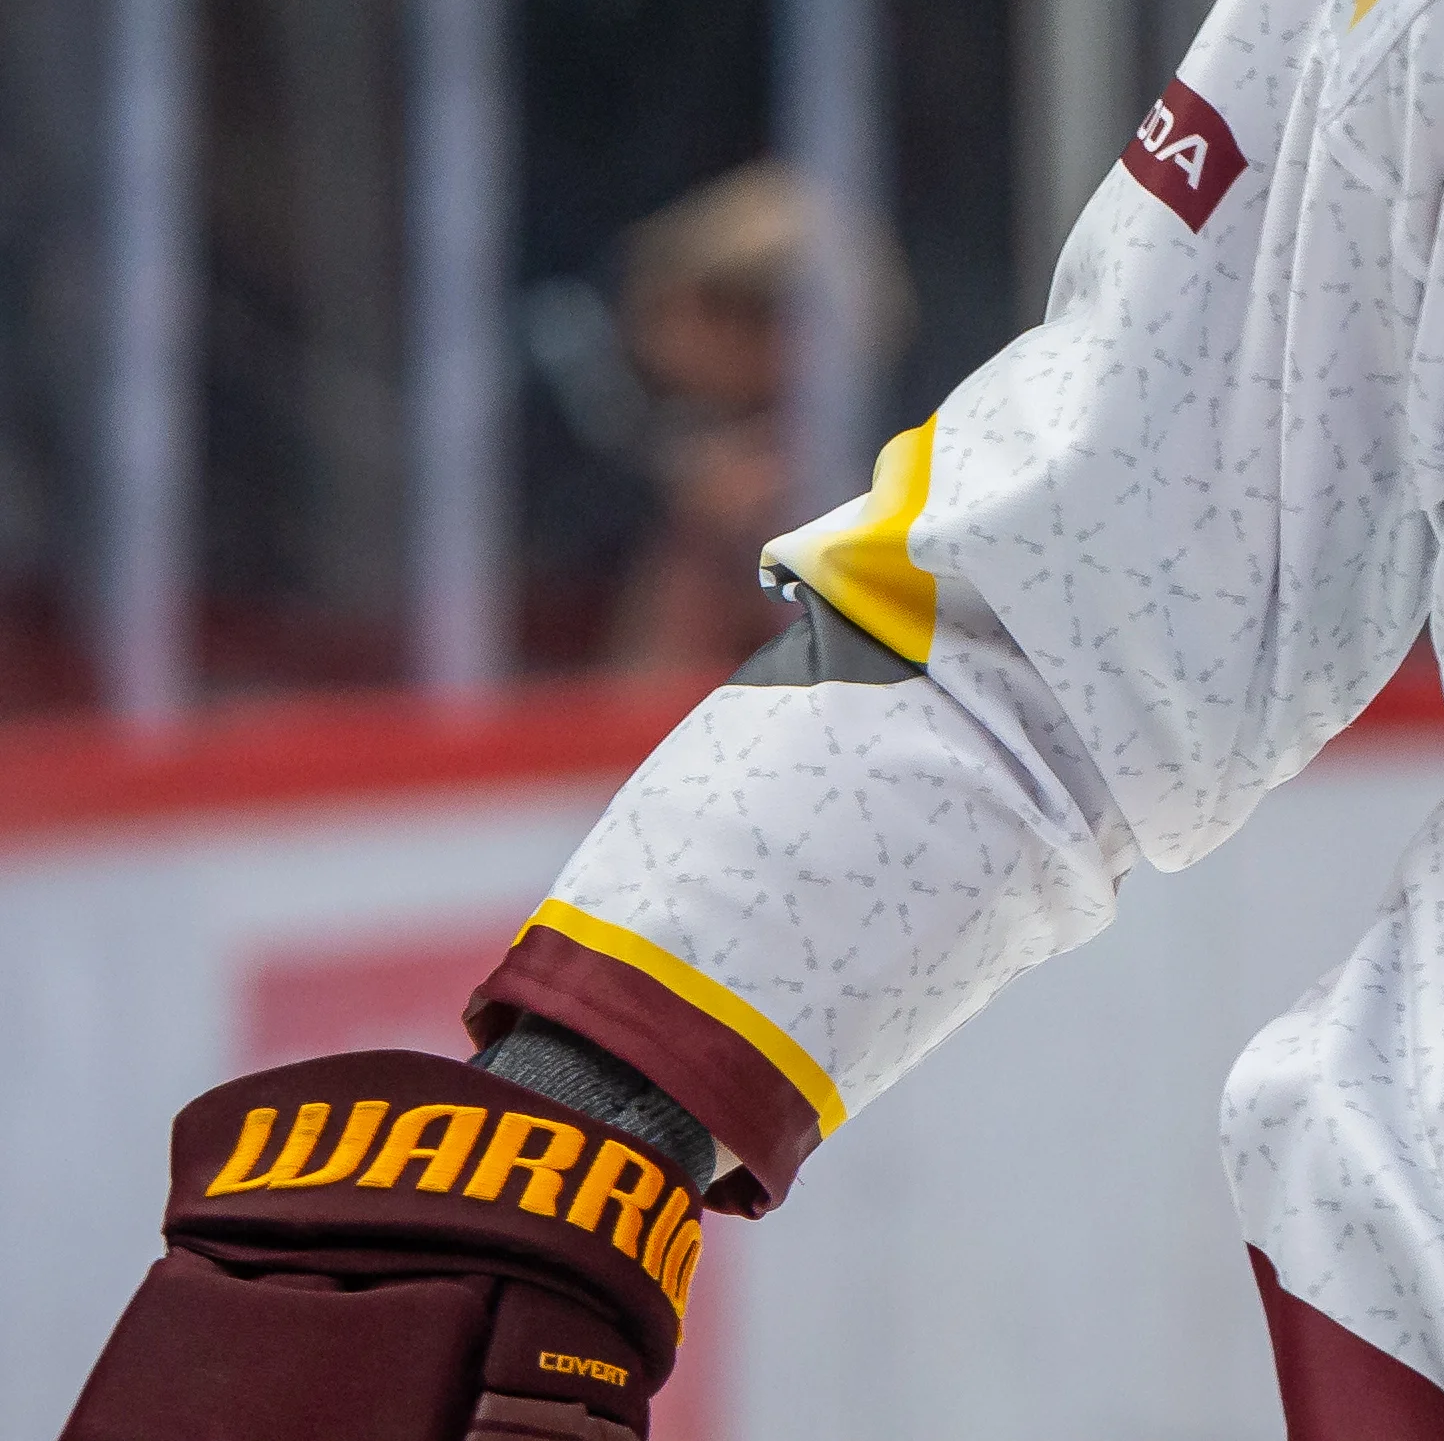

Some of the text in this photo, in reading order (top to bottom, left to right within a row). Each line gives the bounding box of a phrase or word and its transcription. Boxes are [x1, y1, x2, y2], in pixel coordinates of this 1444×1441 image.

[1136, 97, 1209, 191] ODA
[205, 1100, 704, 1348] WARRIO
[538, 1349, 630, 1387] COVERT
